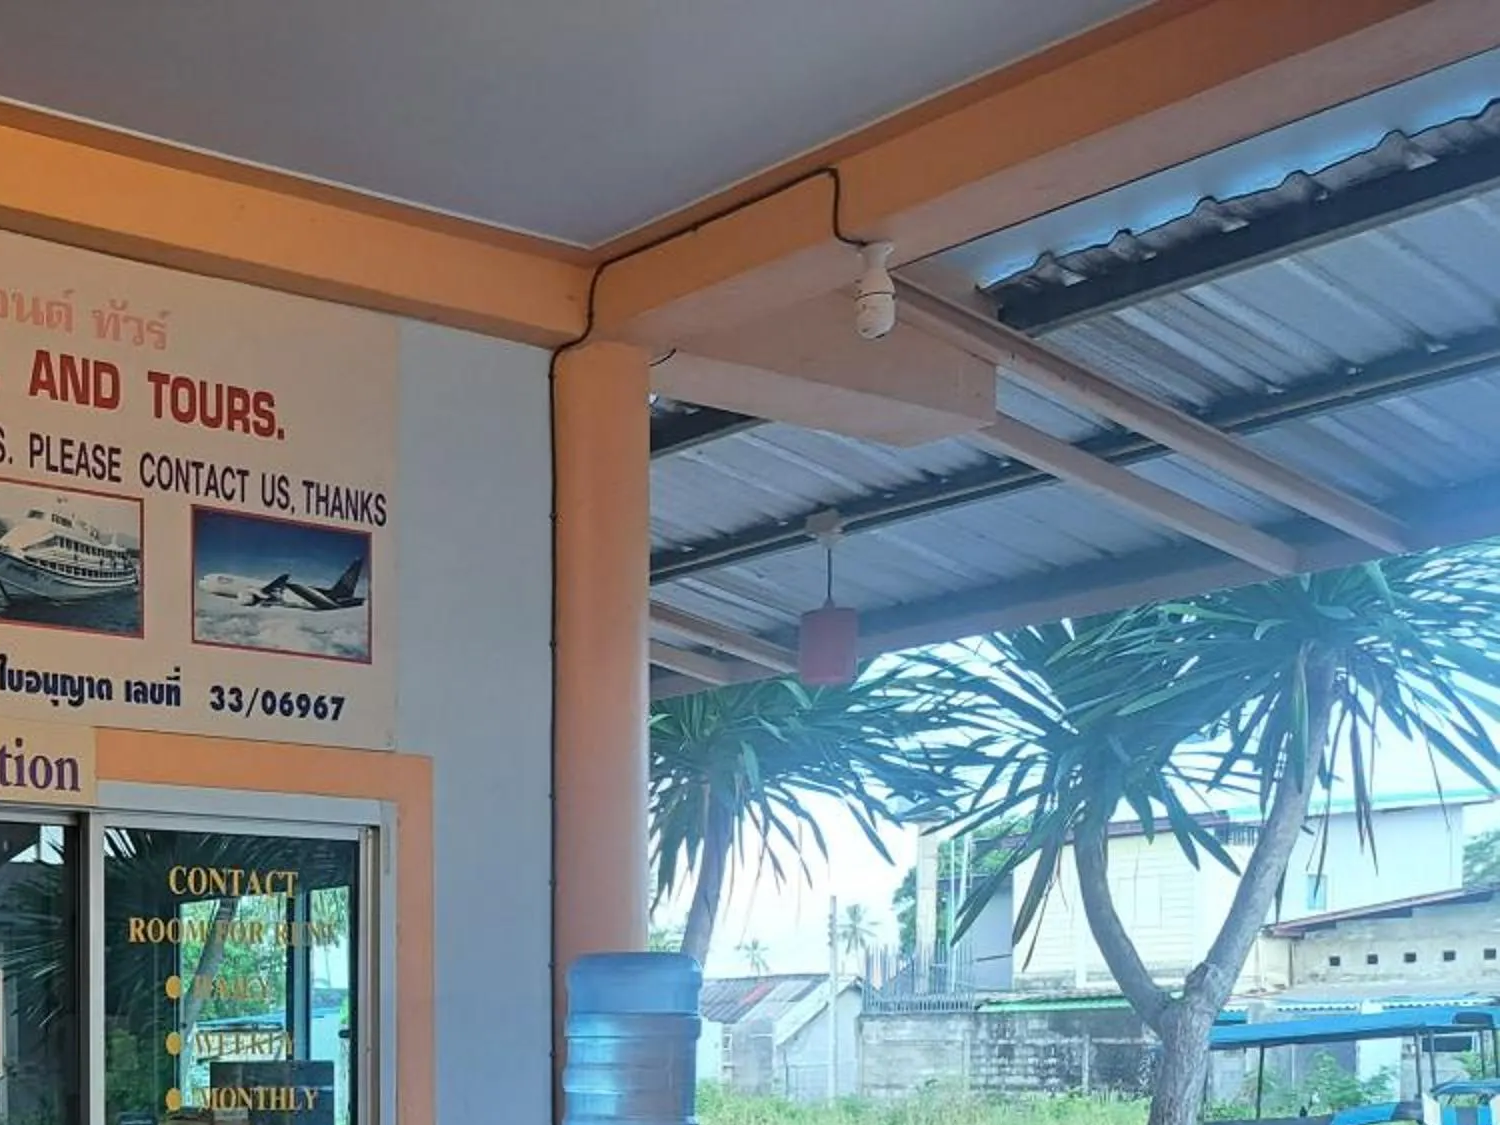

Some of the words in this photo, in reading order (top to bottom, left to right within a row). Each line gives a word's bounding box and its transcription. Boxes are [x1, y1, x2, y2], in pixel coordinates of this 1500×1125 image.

[92, 301, 169, 351] ทัวร์
[29, 349, 120, 410] AND
[148, 371, 286, 441] TOURS.
[28, 432, 122, 483] PLEASE
[140, 453, 250, 505] CONTACT
[260, 475, 298, 516] US,
[301, 478, 388, 528] THANKS
[125, 666, 181, 707] เลขที่
[209, 685, 345, 721] 33/06967
[169, 865, 299, 897] CONTACT
[128, 917, 209, 943] ROOM
[215, 919, 265, 944] FOR
[195, 1031, 293, 1056] WEEKLY
[198, 1086, 318, 1112] MONTHLY
